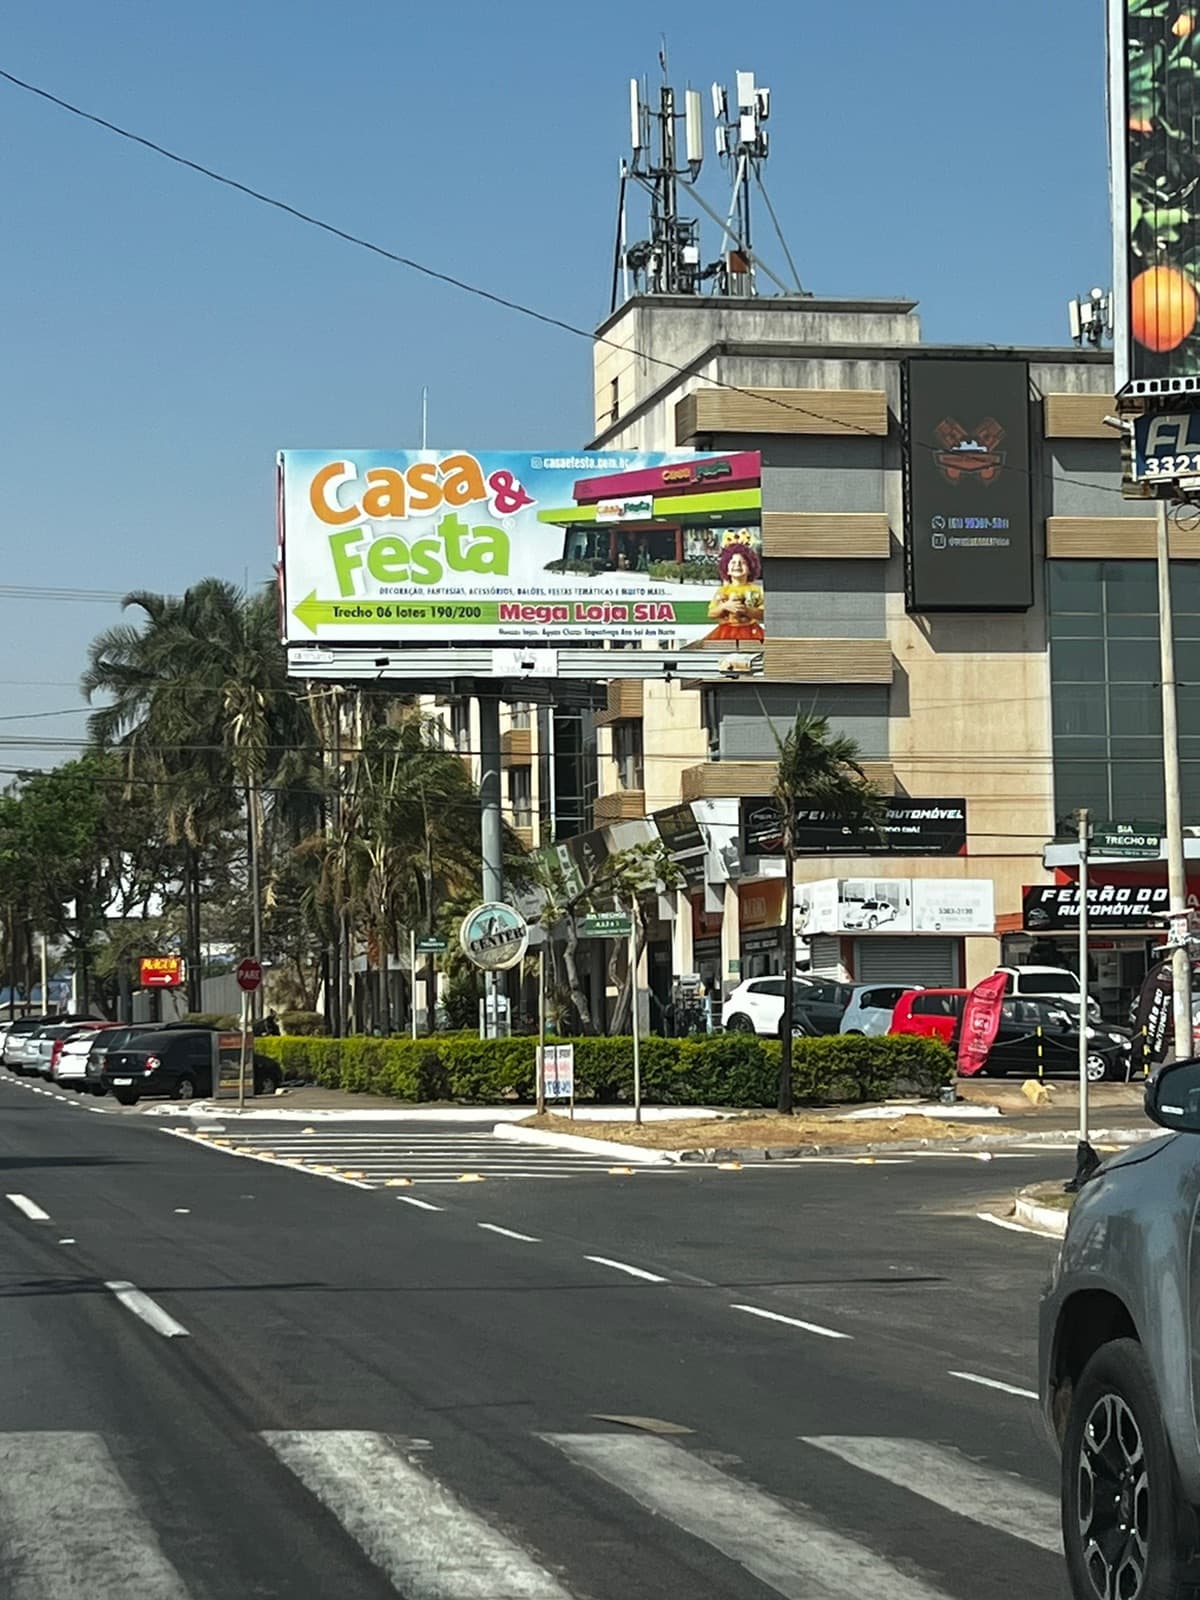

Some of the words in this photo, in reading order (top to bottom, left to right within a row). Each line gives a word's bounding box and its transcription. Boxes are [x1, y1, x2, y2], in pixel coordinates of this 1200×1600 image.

[309, 455, 487, 527] Casa
[490, 470, 538, 515] &
[328, 512, 511, 598] Festa
[333, 606, 373, 618] Trecho
[376, 606, 393, 618] 06
[396, 605, 426, 618] lotes
[431, 606, 482, 619] 190/200
[499, 603, 569, 624] Mega
[574, 602, 628, 624] Loja
[634, 603, 675, 621] SIA
[885, 806, 964, 820] AUTOMÓVEL
[1117, 824, 1134, 834] SIA
[1105, 835, 1145, 846] TRECHO
[1040, 885, 1131, 902] FEIRÃO
[1136, 888, 1168, 902] DO
[470, 924, 527, 952] CENTER
[239, 969, 261, 981] PARE
